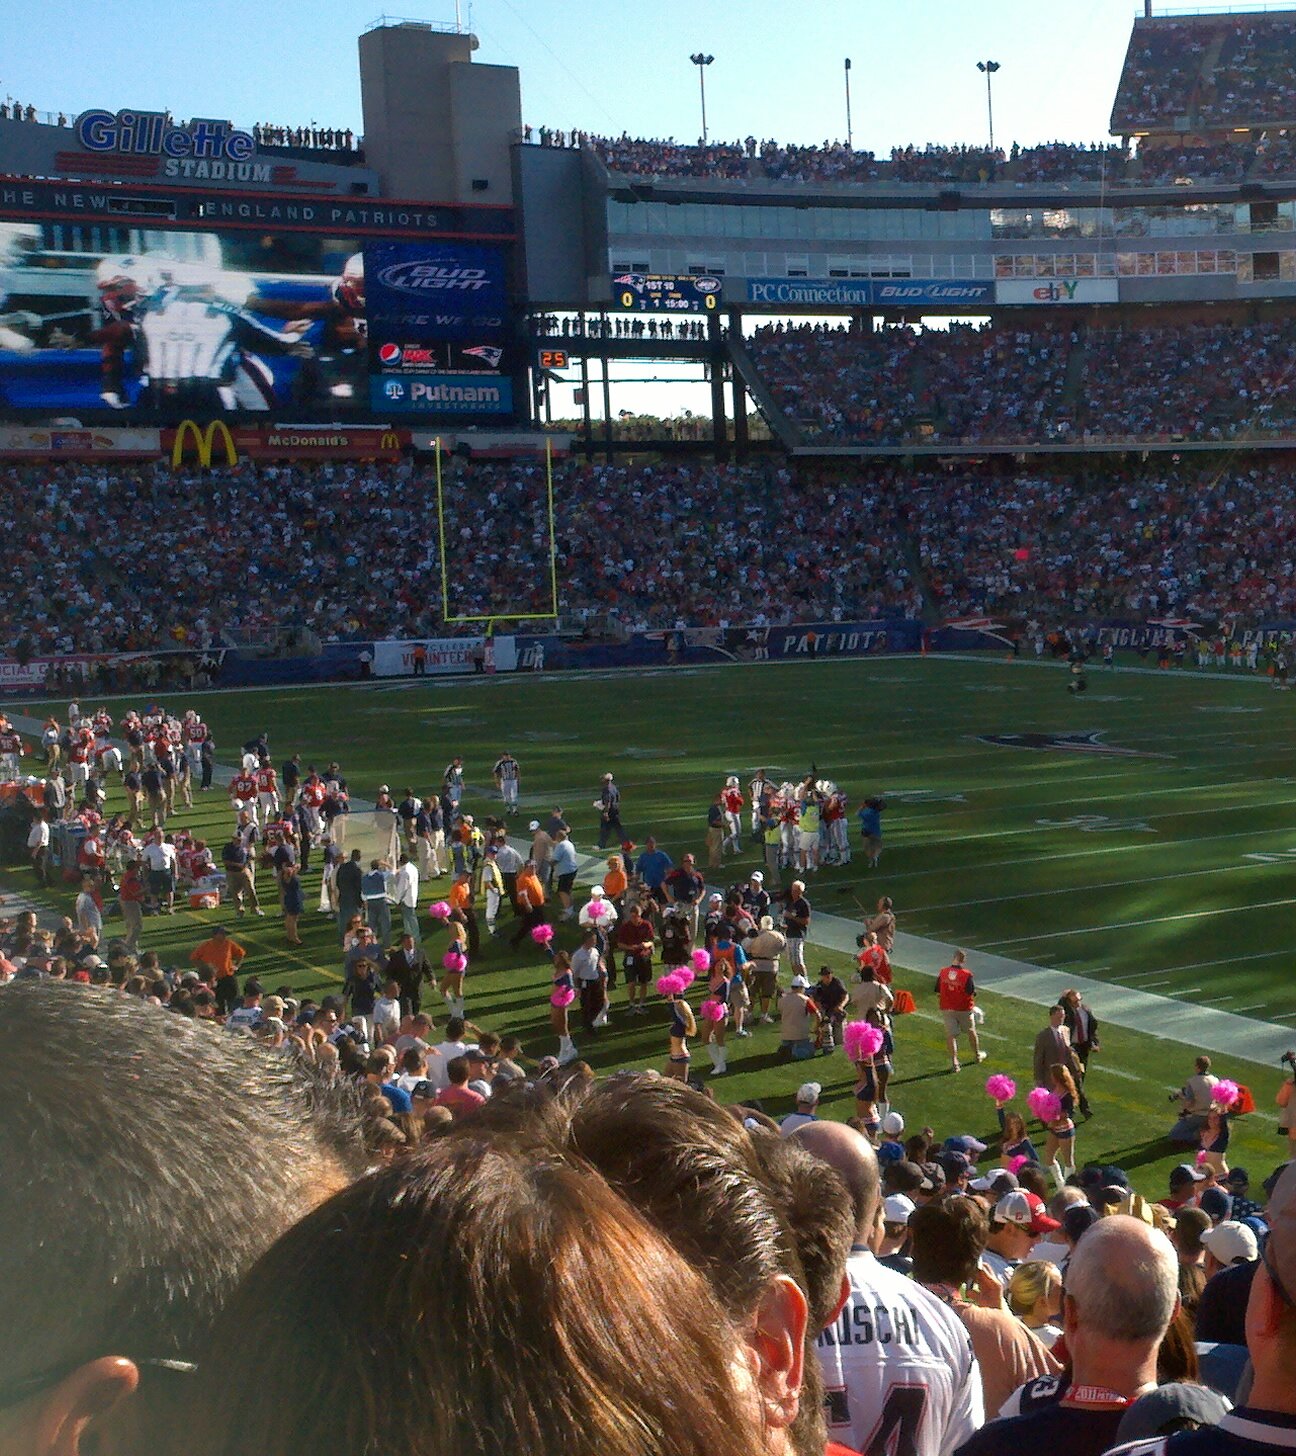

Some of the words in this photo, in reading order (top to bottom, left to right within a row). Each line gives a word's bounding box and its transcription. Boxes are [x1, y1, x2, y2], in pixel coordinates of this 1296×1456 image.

[79, 111, 255, 161] Gillette
[165, 158, 273, 182] STADIUM
[54, 193, 108, 208] NEW
[206, 202, 316, 221] ENGLAND
[331, 208, 438, 227] PATRIOTS
[410, 266, 487, 279] BUD
[394, 278, 491, 290] LIGHT
[752, 283, 776, 302] PC
[777, 284, 866, 303] Connection
[880, 287, 923, 297] BUD
[931, 287, 987, 297] LIGHT
[410, 382, 500, 402] Putnam
[268, 435, 348, 447] McDonald's
